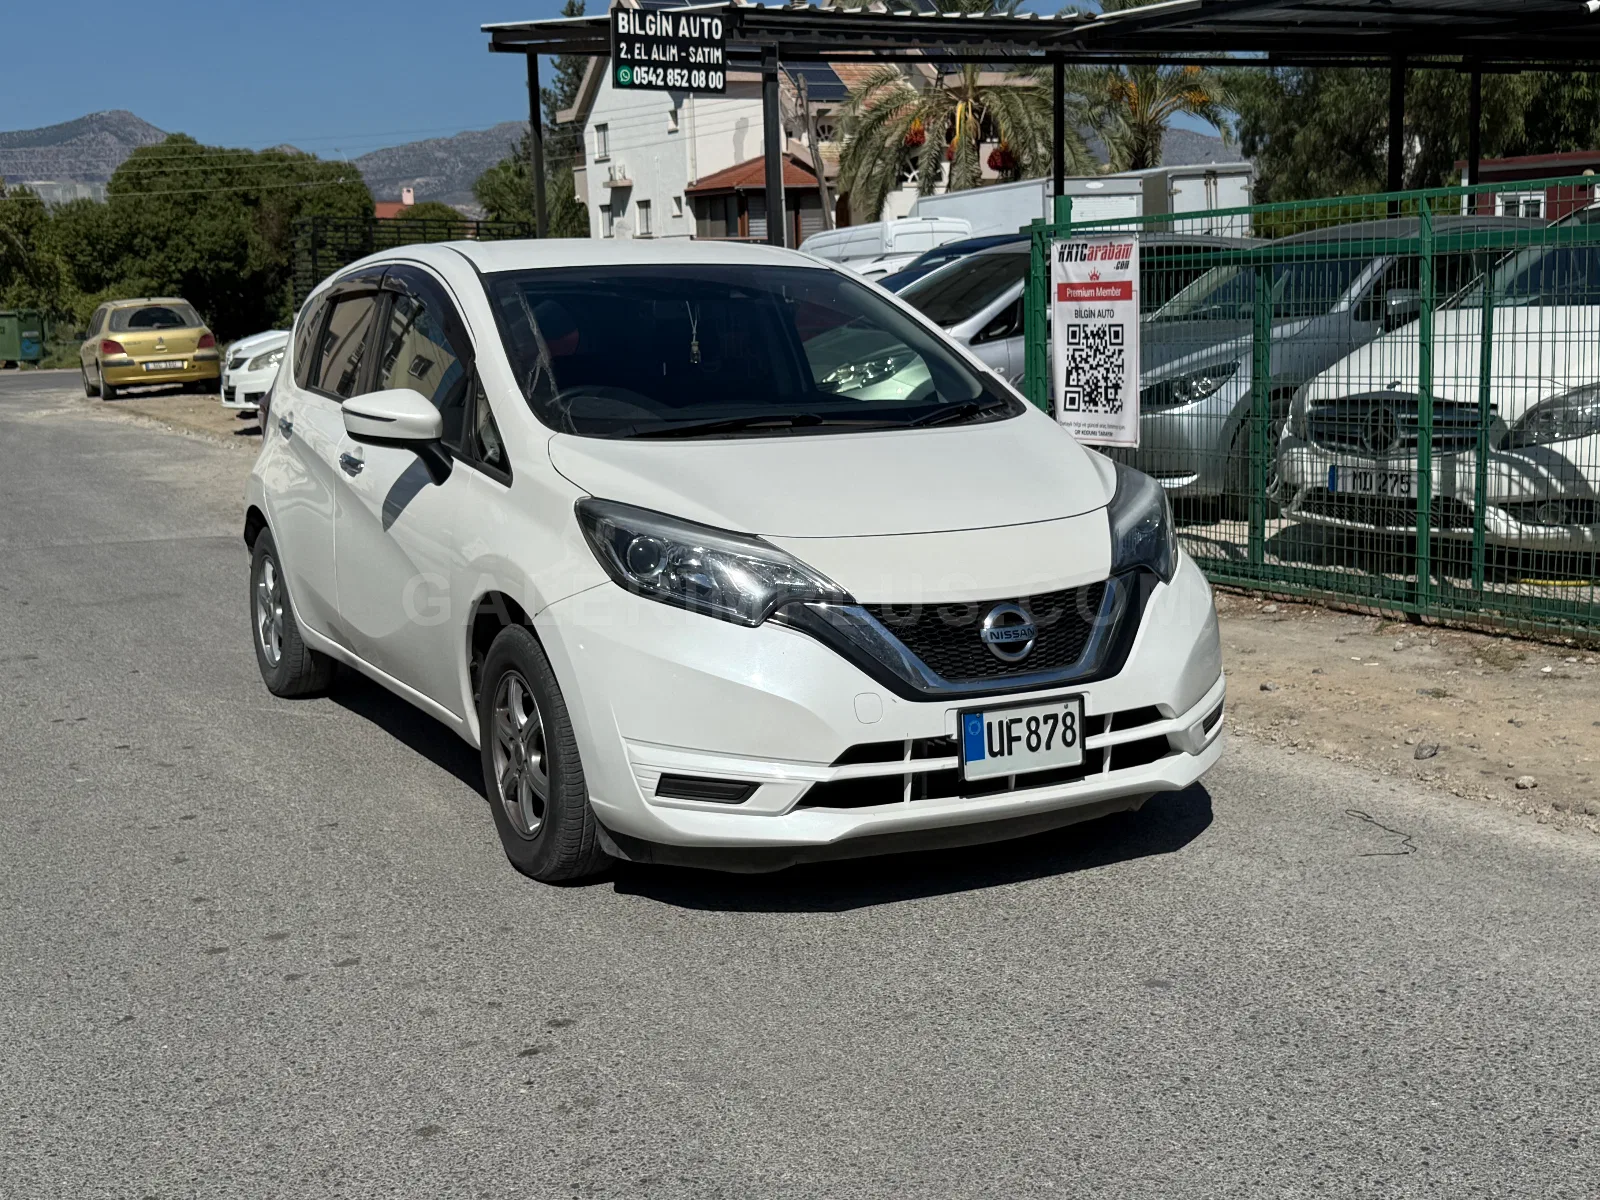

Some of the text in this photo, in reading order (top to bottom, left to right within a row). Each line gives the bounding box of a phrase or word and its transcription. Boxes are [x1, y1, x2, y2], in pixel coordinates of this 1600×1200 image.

[618, 9, 723, 39] BİLGİN AUTO
[634, 43, 648, 60] EL
[651, 44, 678, 61] ALIM
[688, 46, 722, 64] SATIM
[633, 66, 724, 90] 0542 852 08 00
[1066, 286, 1122, 298] Premium Member
[1074, 307, 1114, 318] BİLGİN AUTO
[1378, 472, 1411, 494] 275
[989, 627, 1036, 641] NISSAN
[986, 711, 1077, 758] UF878
